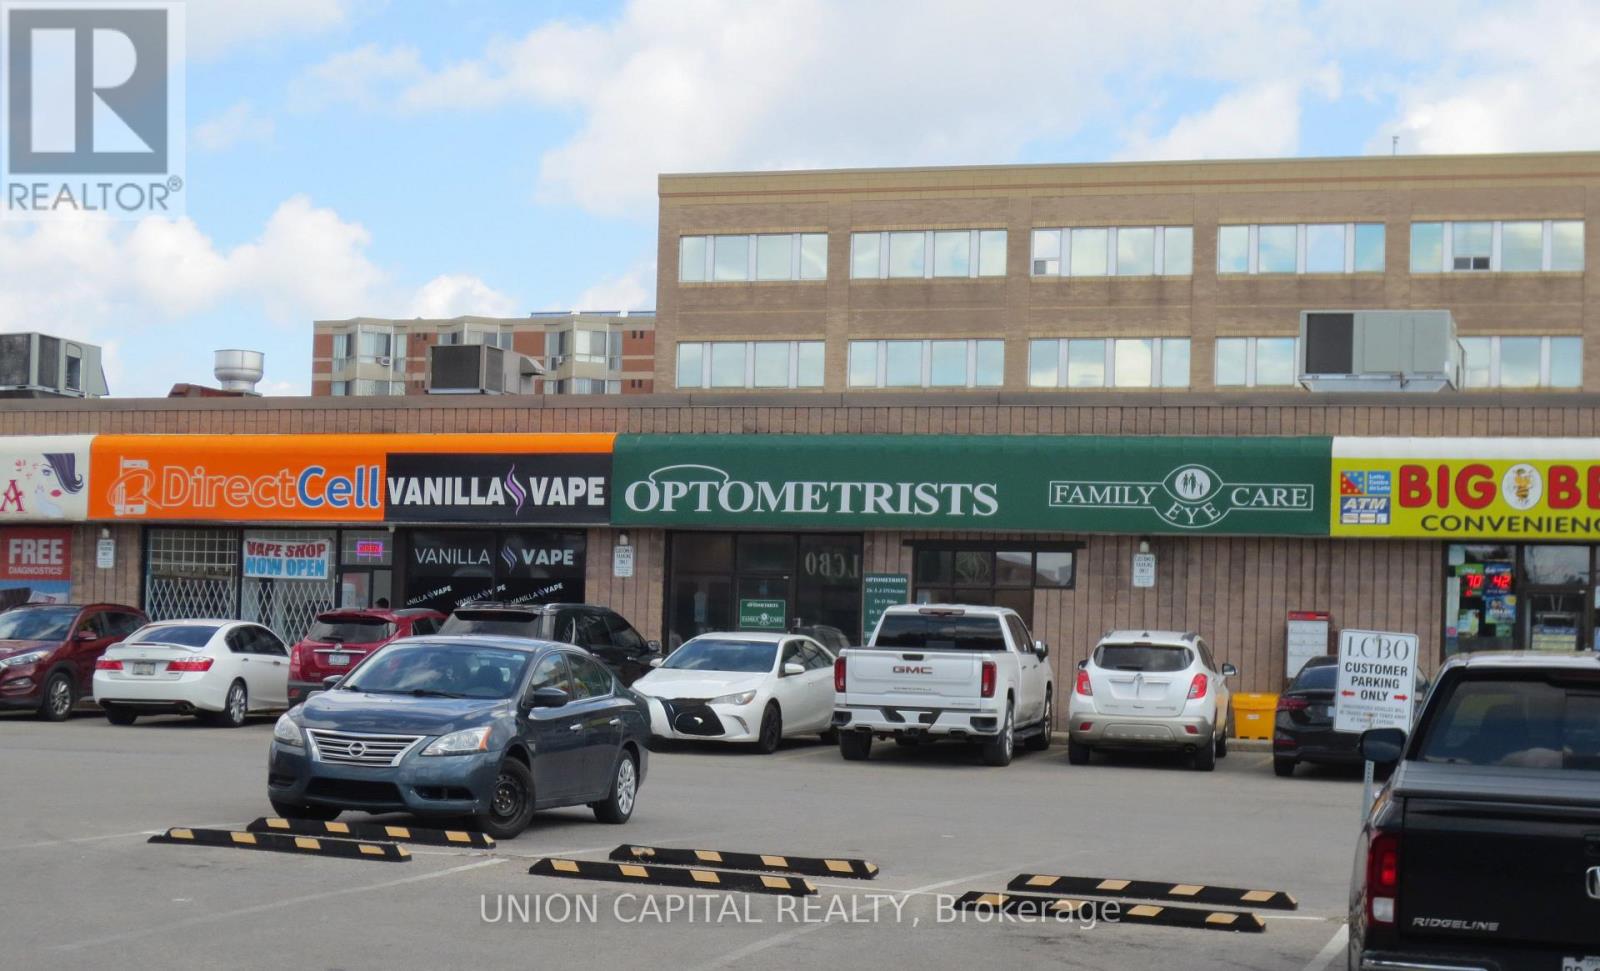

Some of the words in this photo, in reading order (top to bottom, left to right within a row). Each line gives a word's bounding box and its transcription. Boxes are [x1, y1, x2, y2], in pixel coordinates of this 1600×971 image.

[161, 465, 381, 508] DirectCell
[387, 477, 505, 505] VANILLA
[529, 477, 604, 506] VAPE
[1399, 464, 1497, 509] BIG
[625, 480, 999, 516] OPTOMETRISTS
[1054, 485, 1157, 504] FAMILY
[1165, 502, 1221, 525] EYE
[1231, 487, 1308, 507] CARE
[1343, 498, 1387, 510] ATM
[8, 538, 64, 565] FREE
[246, 541, 282, 558] VAPE
[284, 543, 326, 558] SHOP
[415, 548, 491, 565] VANILLA
[521, 549, 574, 566] VAPE
[8, 566, 63, 576] DIAGNOSTICS
[245, 557, 282, 576] NOW
[286, 558, 325, 577] OPEN
[433, 585, 453, 597] VAPE
[544, 582, 564, 594] VAPE
[1347, 635, 1409, 660] LCBO
[893, 665, 933, 674] GMC
[1345, 662, 1408, 676] CUSTOMER
[1351, 676, 1400, 689] PARKING
[1360, 690, 1389, 701] ONLY
[1412, 917, 1499, 931] RIDGELINE
